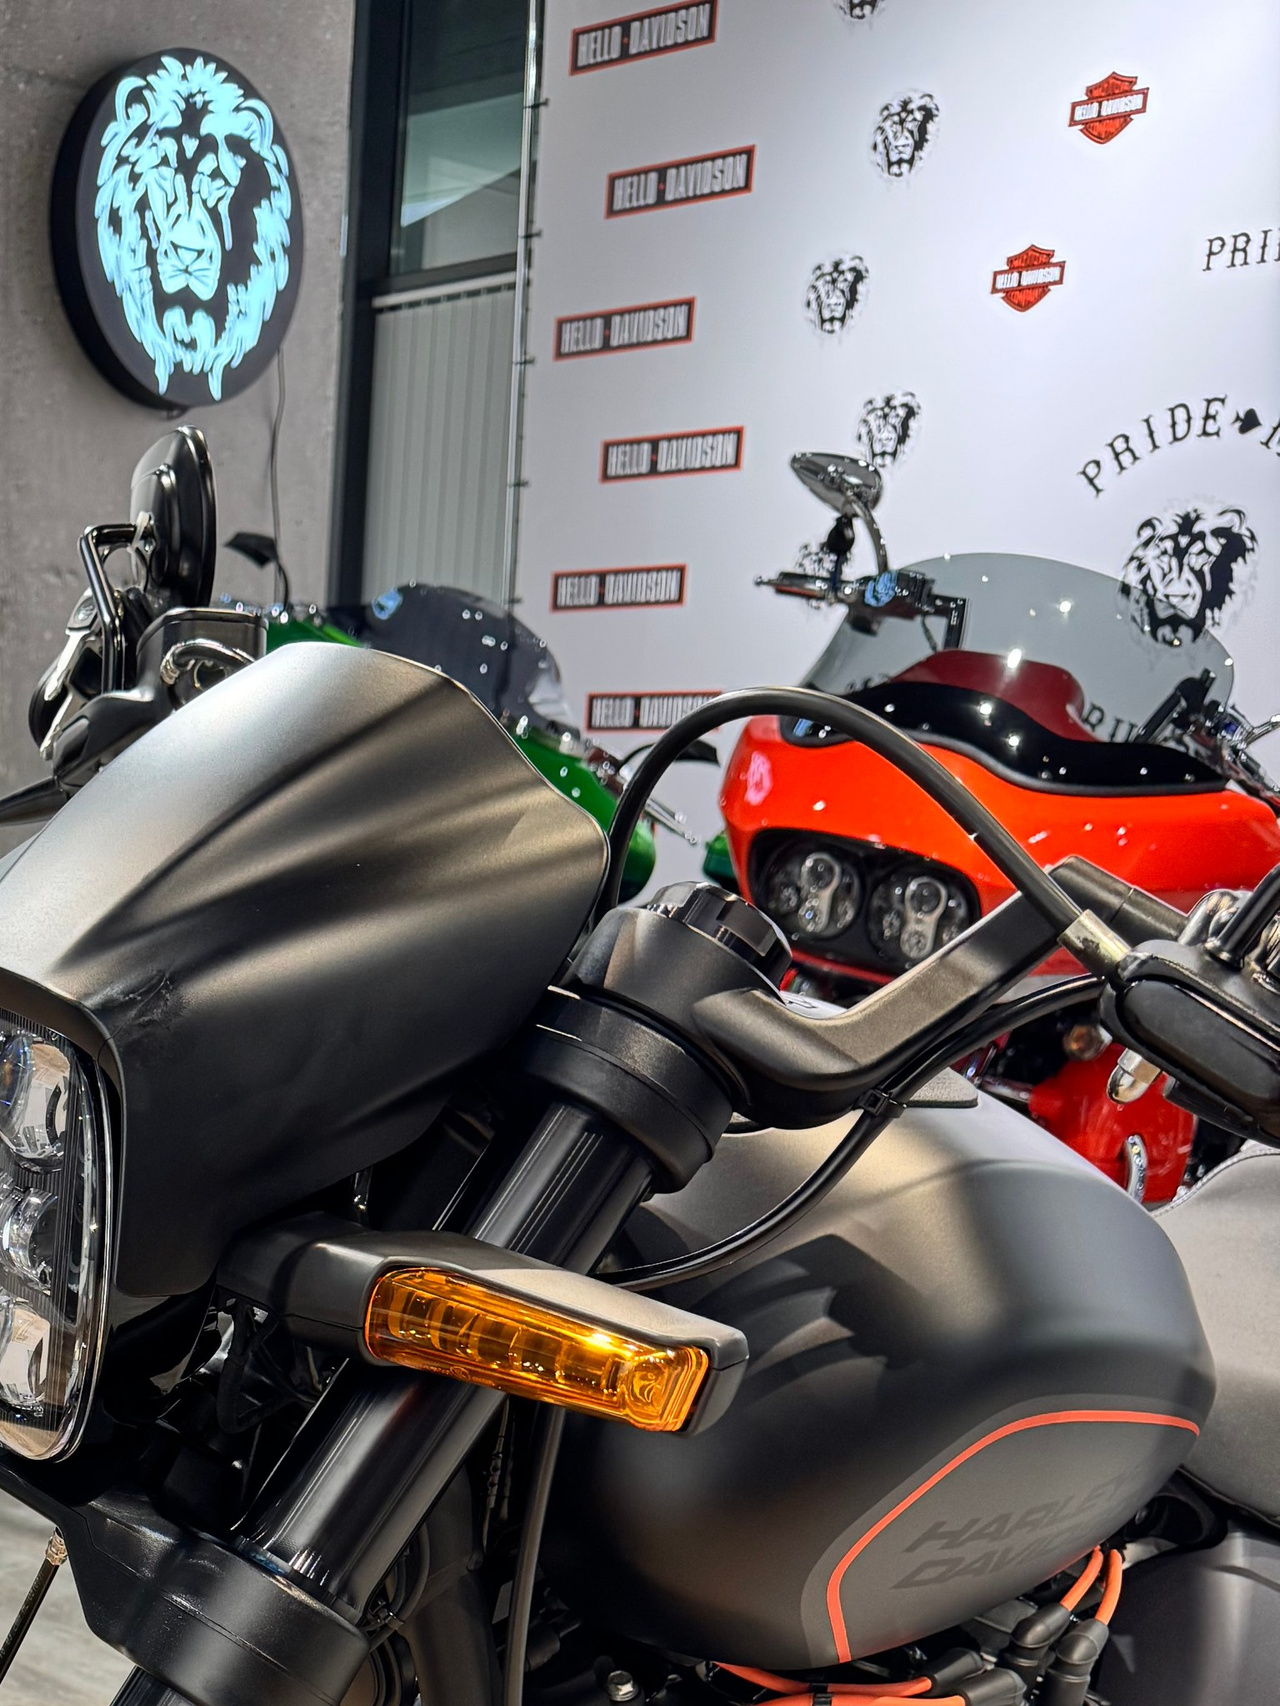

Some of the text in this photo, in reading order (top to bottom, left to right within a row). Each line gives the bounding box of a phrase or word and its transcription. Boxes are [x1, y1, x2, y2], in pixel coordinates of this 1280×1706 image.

[577, 4, 711, 67] HELLO DAVIDSON
[613, 154, 747, 211] HELLO DAVIDSON
[1202, 228, 1280, 272] PRI
[560, 304, 689, 354] HELLO DAVIDSON
[607, 432, 738, 477] HELLO DAVIDSON
[1077, 394, 1228, 498] PRIDE
[557, 569, 681, 607] HELLO DAVIDSON
[591, 697, 634, 728] HELLO
